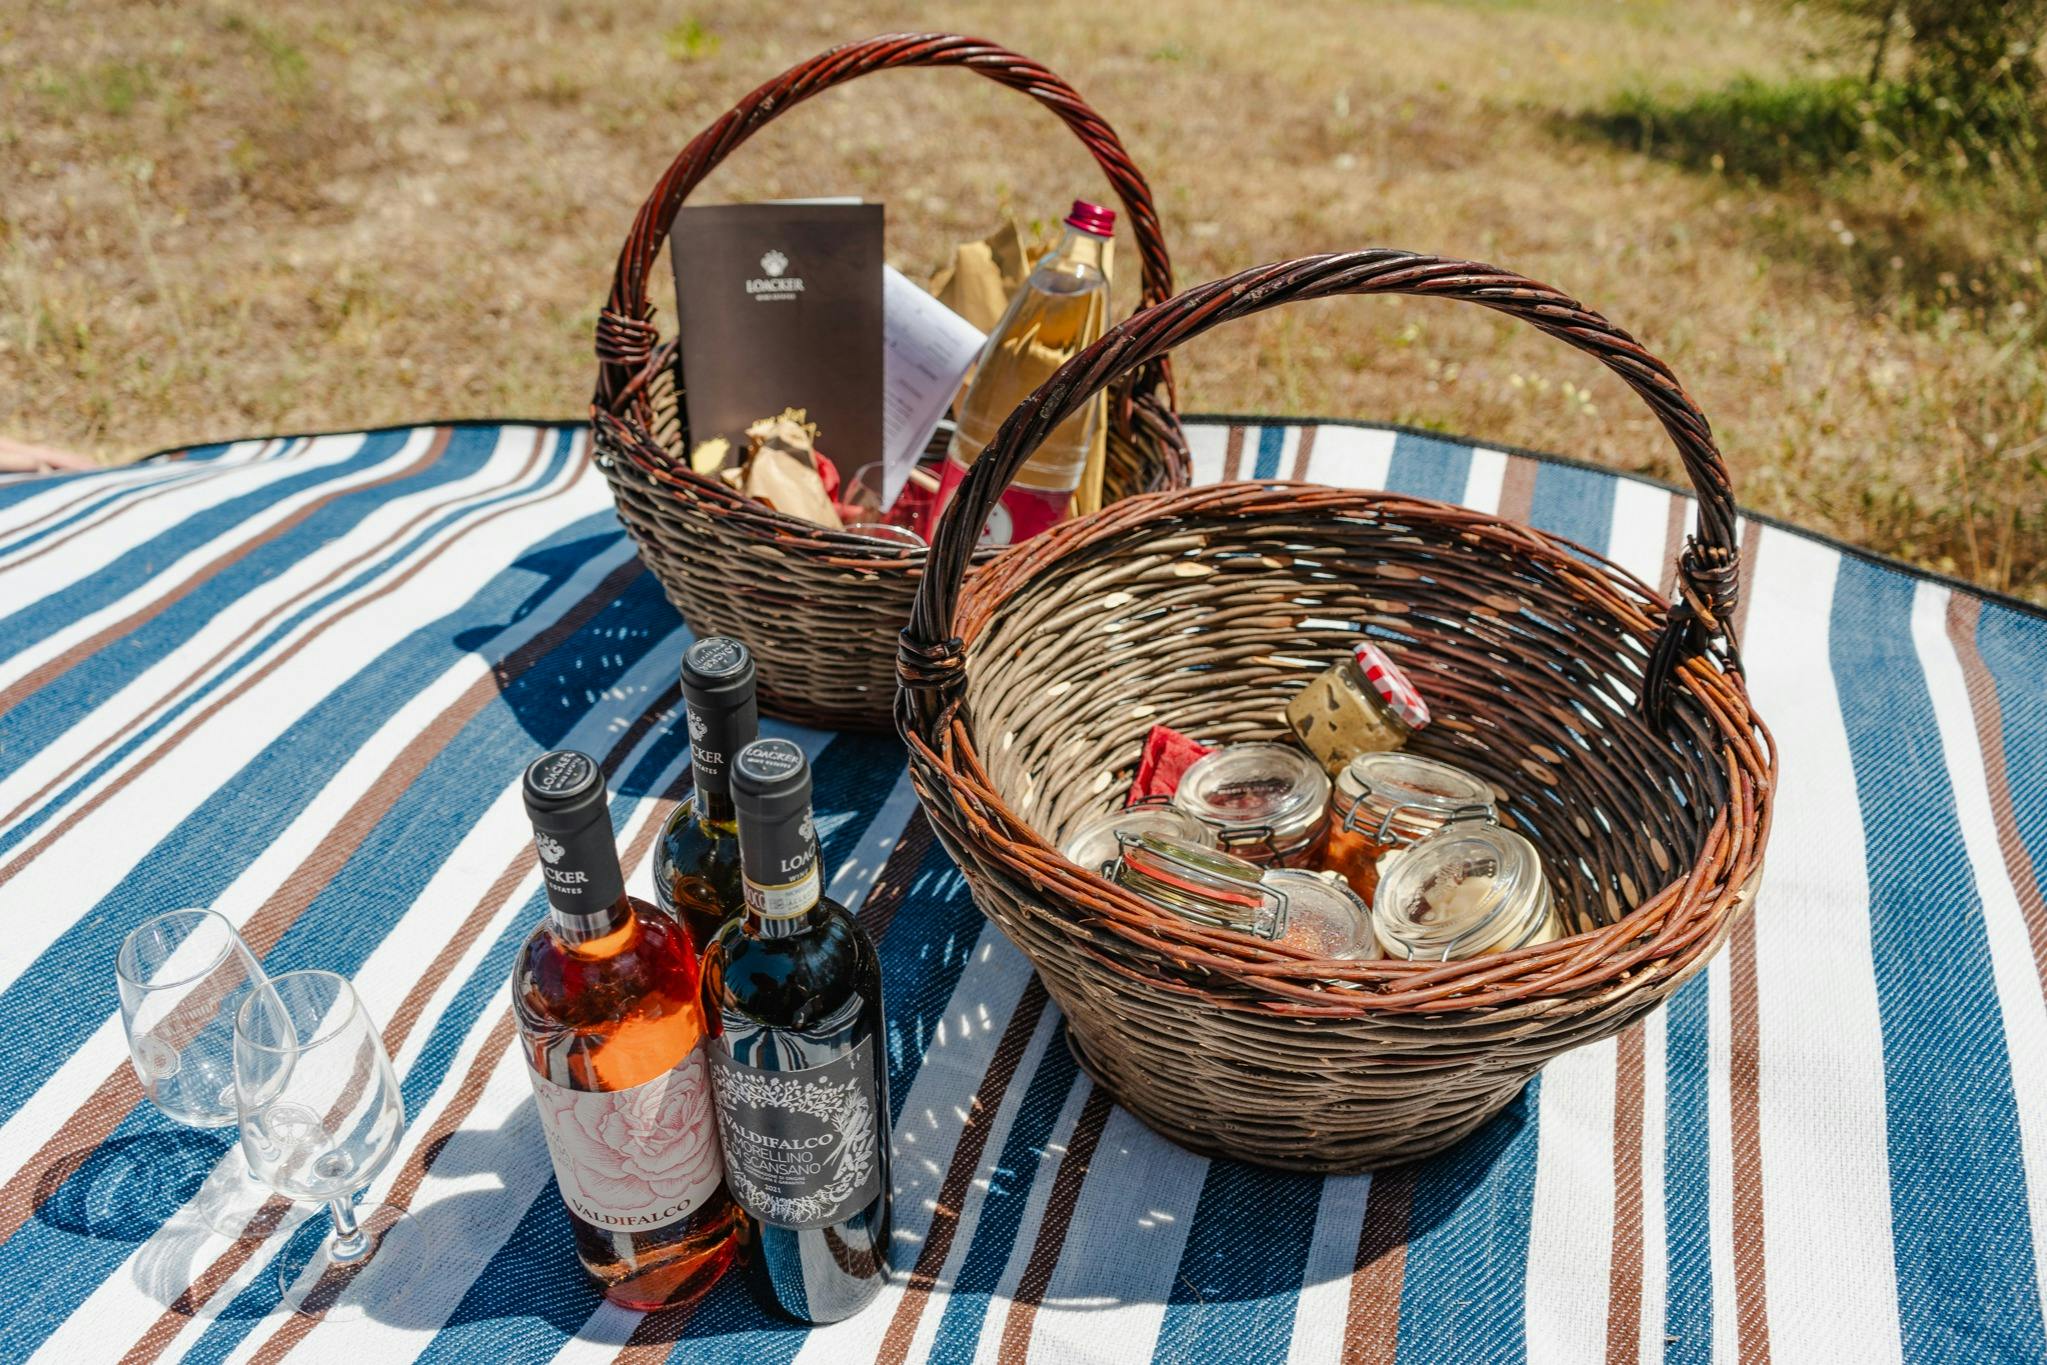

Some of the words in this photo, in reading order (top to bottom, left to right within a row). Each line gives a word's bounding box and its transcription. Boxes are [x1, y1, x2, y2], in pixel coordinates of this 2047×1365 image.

[746, 277, 805, 293] LOACKER
[692, 743, 724, 764] CKER
[745, 748, 800, 764] LOACKER
[540, 753, 577, 791] LOACKER
[544, 866, 590, 884] CKER
[722, 1110, 834, 1150] VALDIFALCO
[733, 1133, 813, 1163] MORELLINO
[743, 1151, 821, 1175] SCANSANO
[763, 1184, 782, 1193] 2021
[571, 1198, 692, 1226] VALDIFALCO
